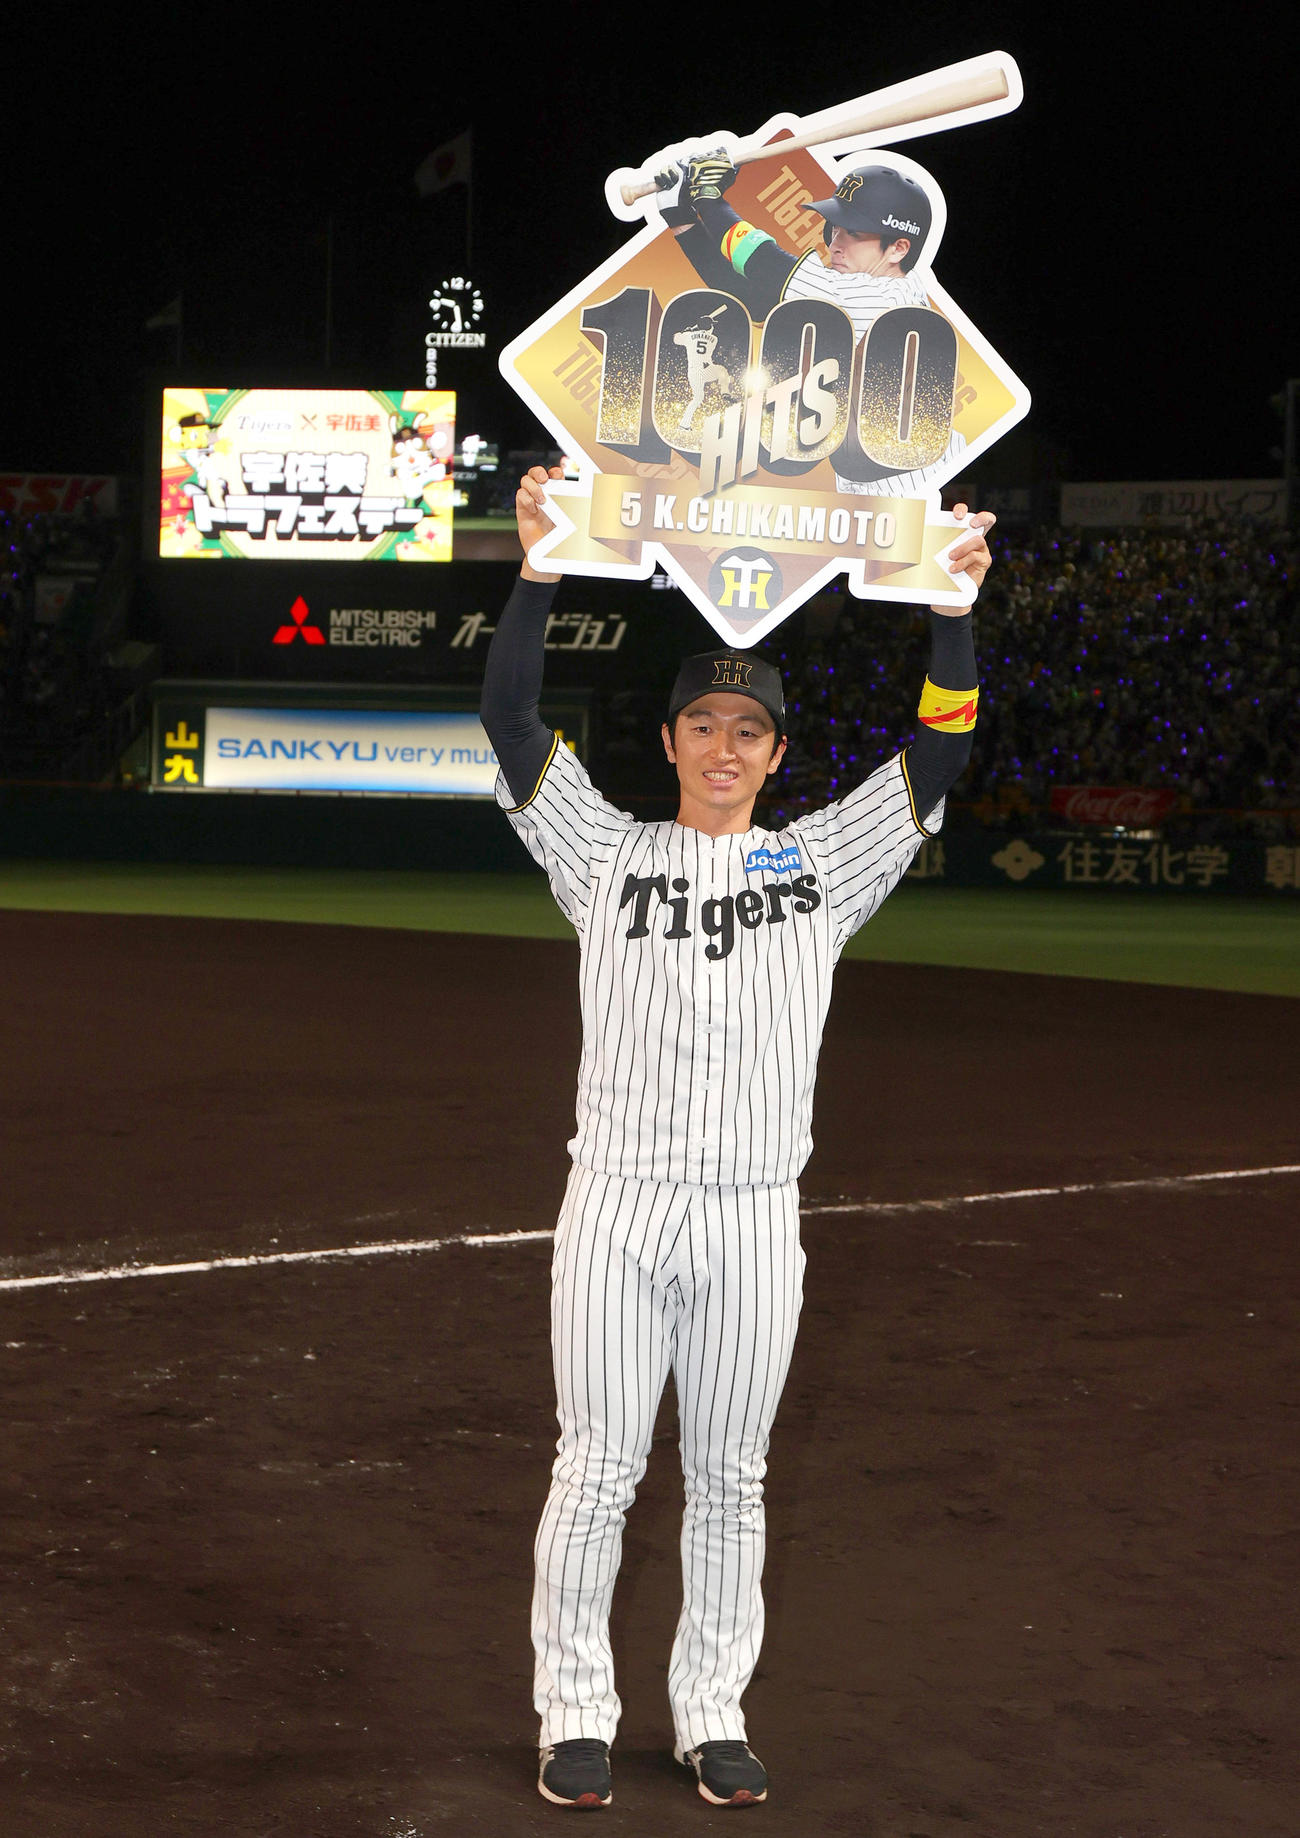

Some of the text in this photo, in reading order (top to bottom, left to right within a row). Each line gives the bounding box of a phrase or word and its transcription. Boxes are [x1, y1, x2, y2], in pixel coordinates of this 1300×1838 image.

[881, 213, 921, 236] Joshin
[425, 332, 486, 349] CITIZEN
[696, 341, 707, 354] 5
[580, 287, 959, 471] 1000
[238, 415, 292, 433] Tigers
[326, 413, 382, 432] 宇佐美
[702, 357, 840, 496] HITS
[241, 451, 369, 494] 宇佐美
[620, 491, 897, 549] 5 K.CHIKAMOTO
[329, 609, 437, 629] MITSUBISHI
[451, 610, 628, 651] オービジョン
[329, 627, 422, 647] ELECTRIC
[163, 721, 199, 783] 山九
[217, 738, 378, 761] SANKYU
[385, 745, 444, 766] very
[746, 852, 800, 870] Joshin
[1057, 840, 1229, 887] 住友化学
[620, 873, 821, 961] Tigers
